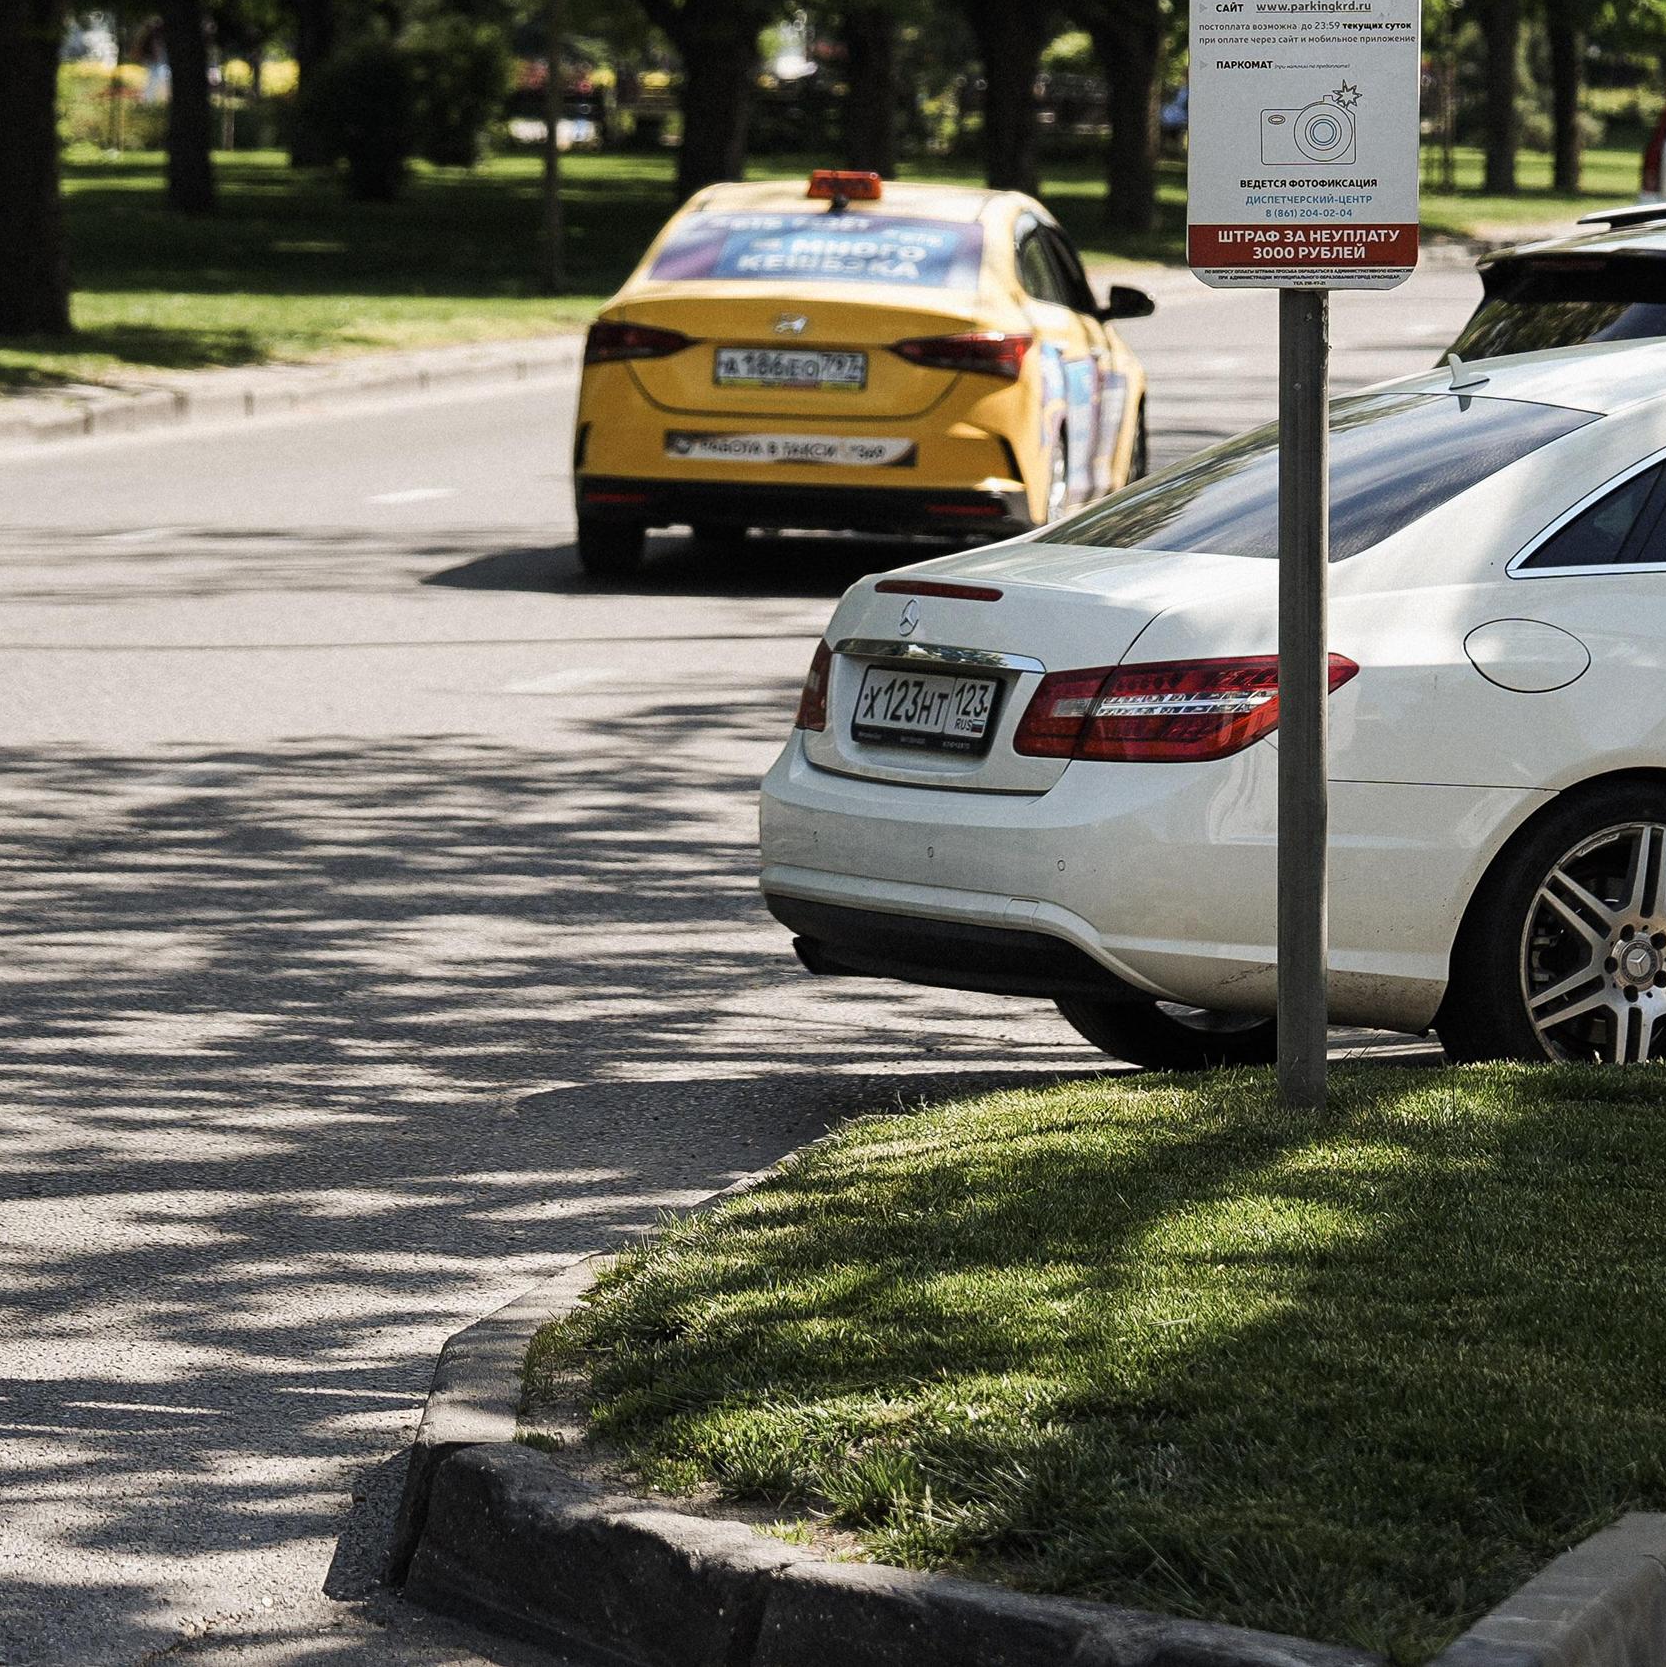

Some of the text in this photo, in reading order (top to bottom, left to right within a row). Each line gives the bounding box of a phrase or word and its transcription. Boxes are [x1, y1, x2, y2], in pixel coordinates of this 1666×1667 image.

[1216, 3, 1244, 13] САЙТ
[1256, 1, 1372, 13] www.parkingkrd.ru
[1199, 22, 1412, 31] постоплата возможна до 23:59 текущих суток
[1199, 37, 1216, 45] при
[1217, 37, 1249, 45] оплате
[1250, 36, 1276, 45] через
[1278, 35, 1299, 43] сайт
[1308, 35, 1358, 43] мобильное
[1359, 36, 1416, 44] приложение
[1216, 60, 1273, 69] ПАРКОМАТ
[1240, 179, 1378, 189] ВЕДЕТСЯ ФОТОФИКСАЦИЯ
[1246, 194, 1373, 205] ДИСПЕТЧЕРСКИЙ-ЦЕНТР
[1266, 209, 1352, 218] 8 (861) 204-02-04
[1218, 230, 1400, 243] ШТРАФ ЗА НЕУПЛАТУ
[1253, 243, 1366, 259] 3000 РУБЛЕЙ
[955, 682, 990, 718] 123
[954, 718, 973, 732] RUS
